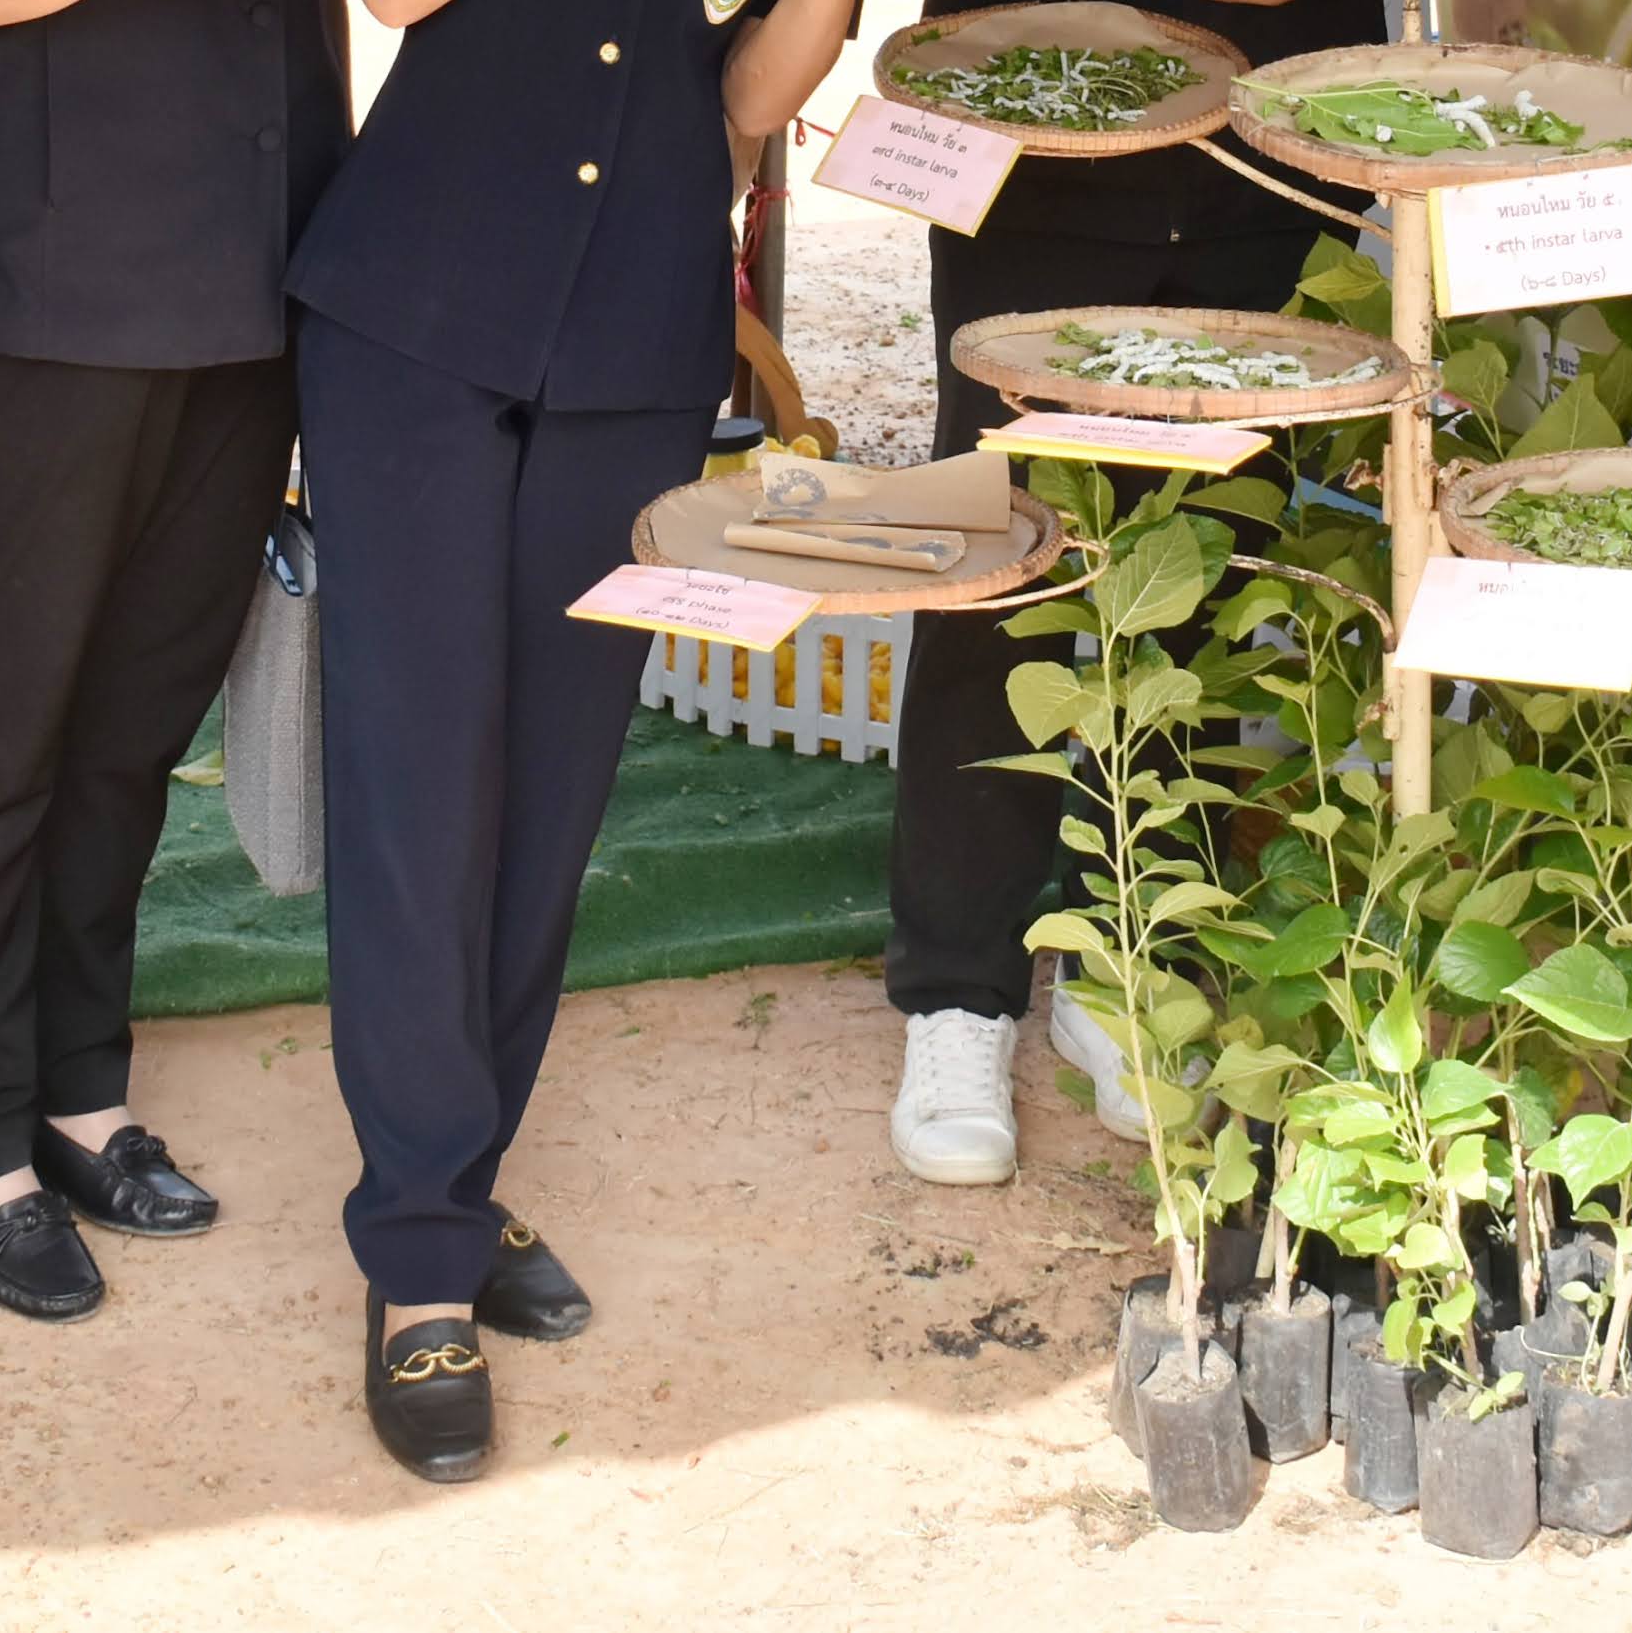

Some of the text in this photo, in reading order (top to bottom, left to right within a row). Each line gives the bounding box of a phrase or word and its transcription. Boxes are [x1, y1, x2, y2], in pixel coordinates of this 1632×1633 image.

[890, 119, 941, 145] หนอนไหม
[942, 134, 958, 150] วัย
[895, 146, 929, 169] instar
[929, 158, 959, 179] larva
[897, 181, 932, 203] Days)
[1496, 194, 1571, 220] หนอนไหม
[1576, 189, 1597, 210] วัย
[1530, 229, 1576, 252] instar
[1582, 225, 1624, 245] larva
[1561, 265, 1607, 287] Days)
[687, 600, 733, 615] phase
